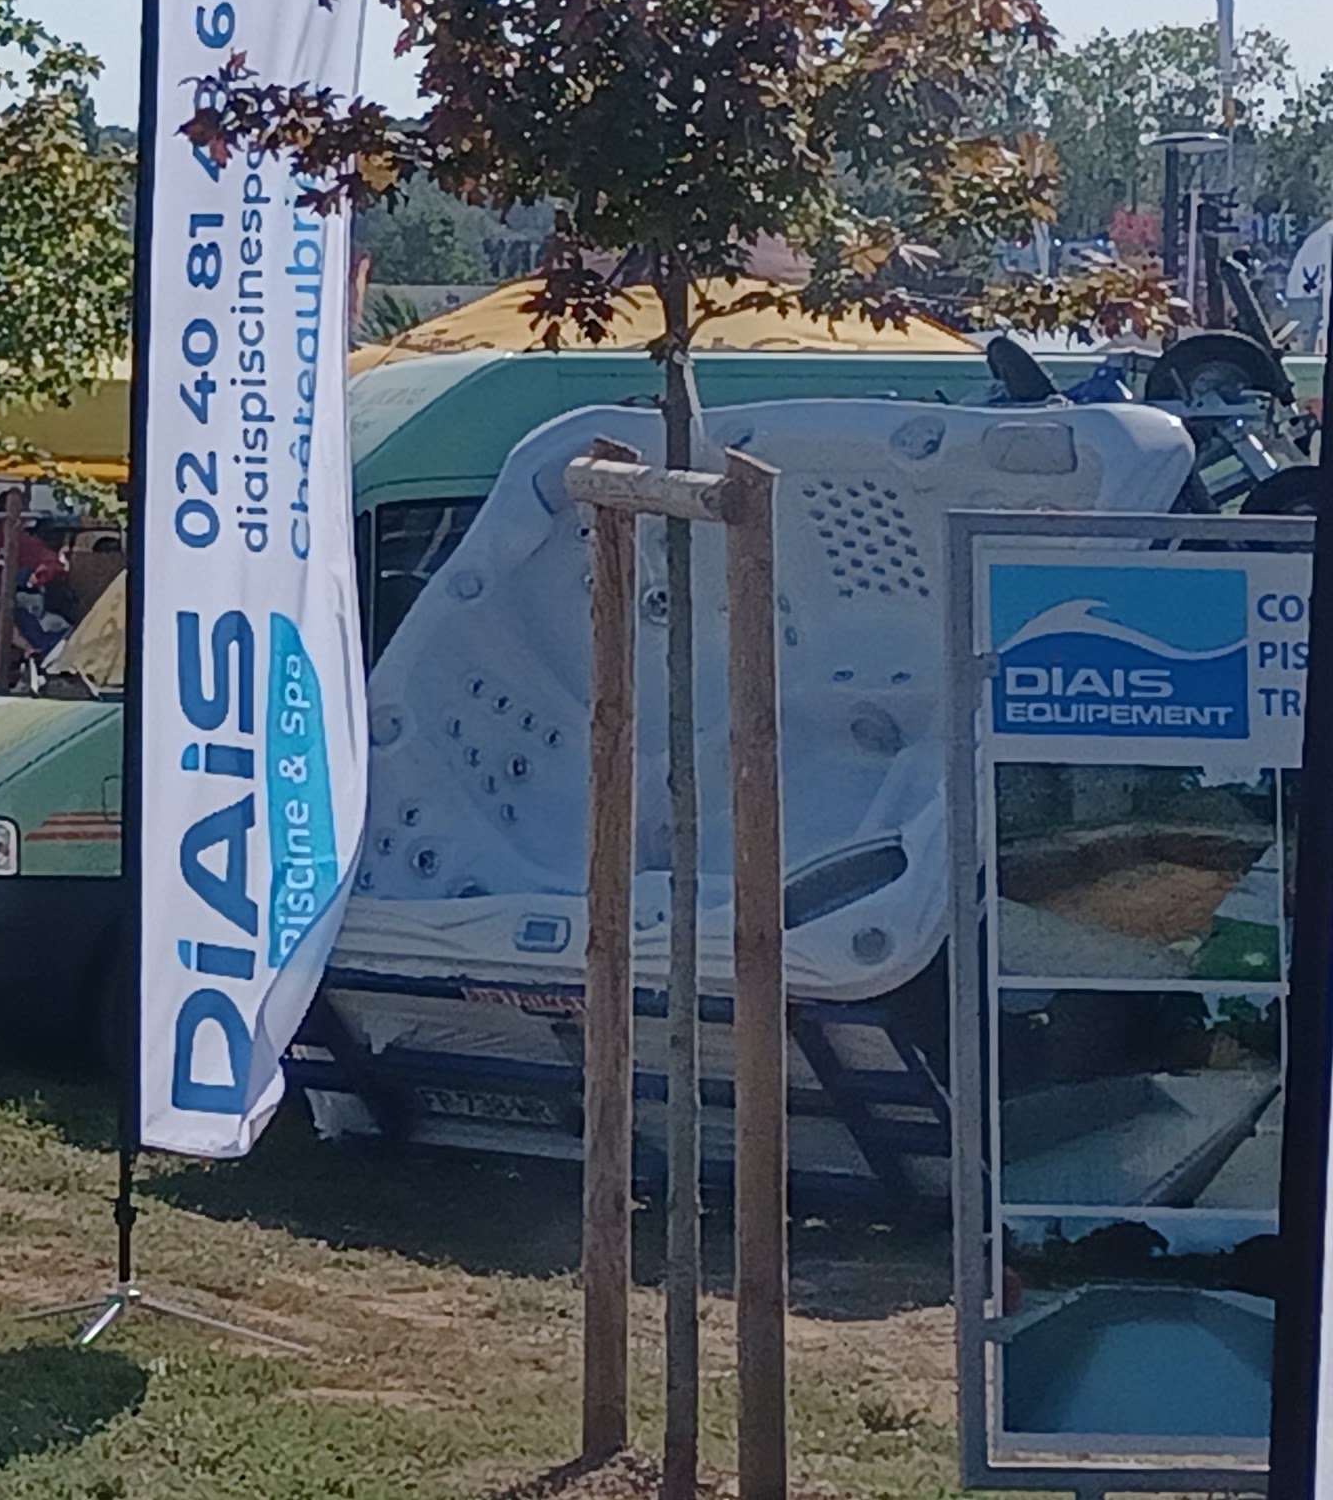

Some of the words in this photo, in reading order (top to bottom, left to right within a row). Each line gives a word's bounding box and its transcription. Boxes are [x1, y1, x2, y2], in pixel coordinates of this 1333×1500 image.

[185, 212, 225, 290] 81
[179, 317, 219, 424] 40
[173, 451, 221, 549] 02
[1005, 666, 1174, 698] DIAIS
[1005, 702, 1234, 727] EQUIPEMENT
[278, 755, 308, 785] &
